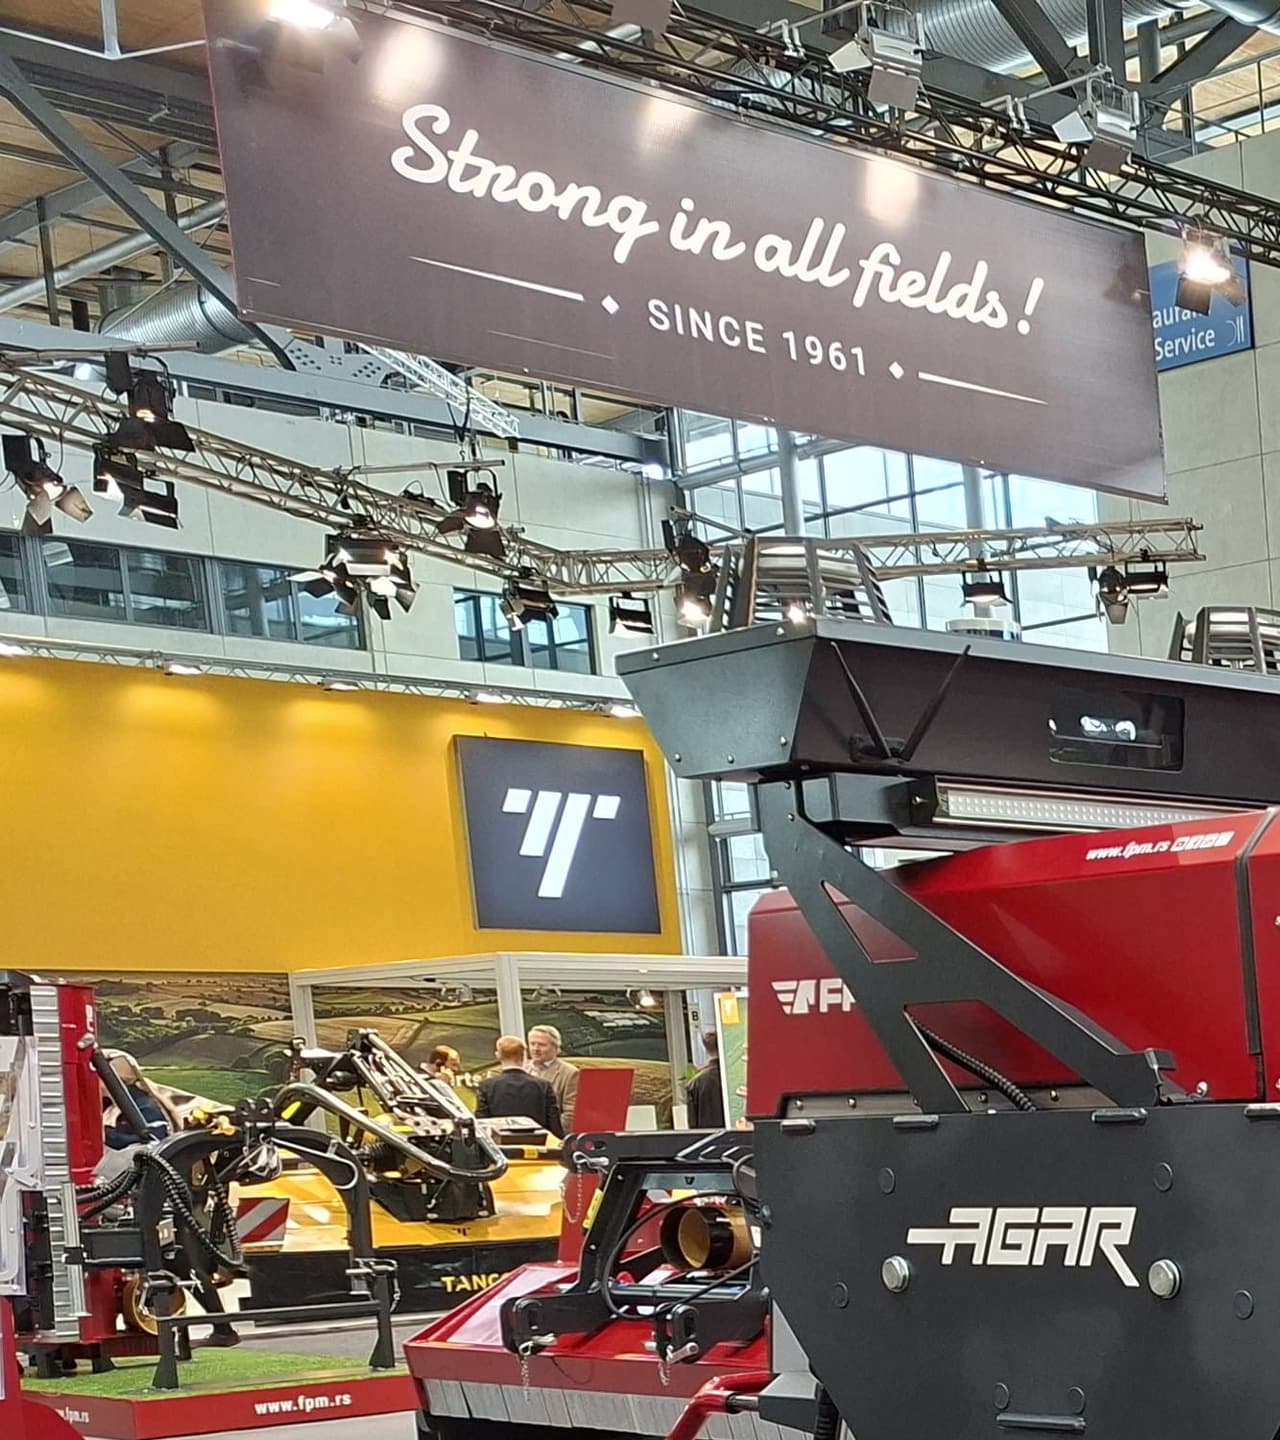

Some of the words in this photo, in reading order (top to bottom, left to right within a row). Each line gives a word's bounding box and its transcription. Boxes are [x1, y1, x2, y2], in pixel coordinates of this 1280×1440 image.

[391, 104, 659, 262] Strong
[669, 197, 745, 262] in
[753, 216, 850, 288] all
[647, 297, 767, 356] SINCE
[780, 331, 870, 378] 1961
[1155, 328, 1216, 361] Service
[1085, 841, 1172, 861] www.fpm.rs
[907, 1206, 1140, 1288] AGAR
[254, 1392, 353, 1416] www.fpm.rs
